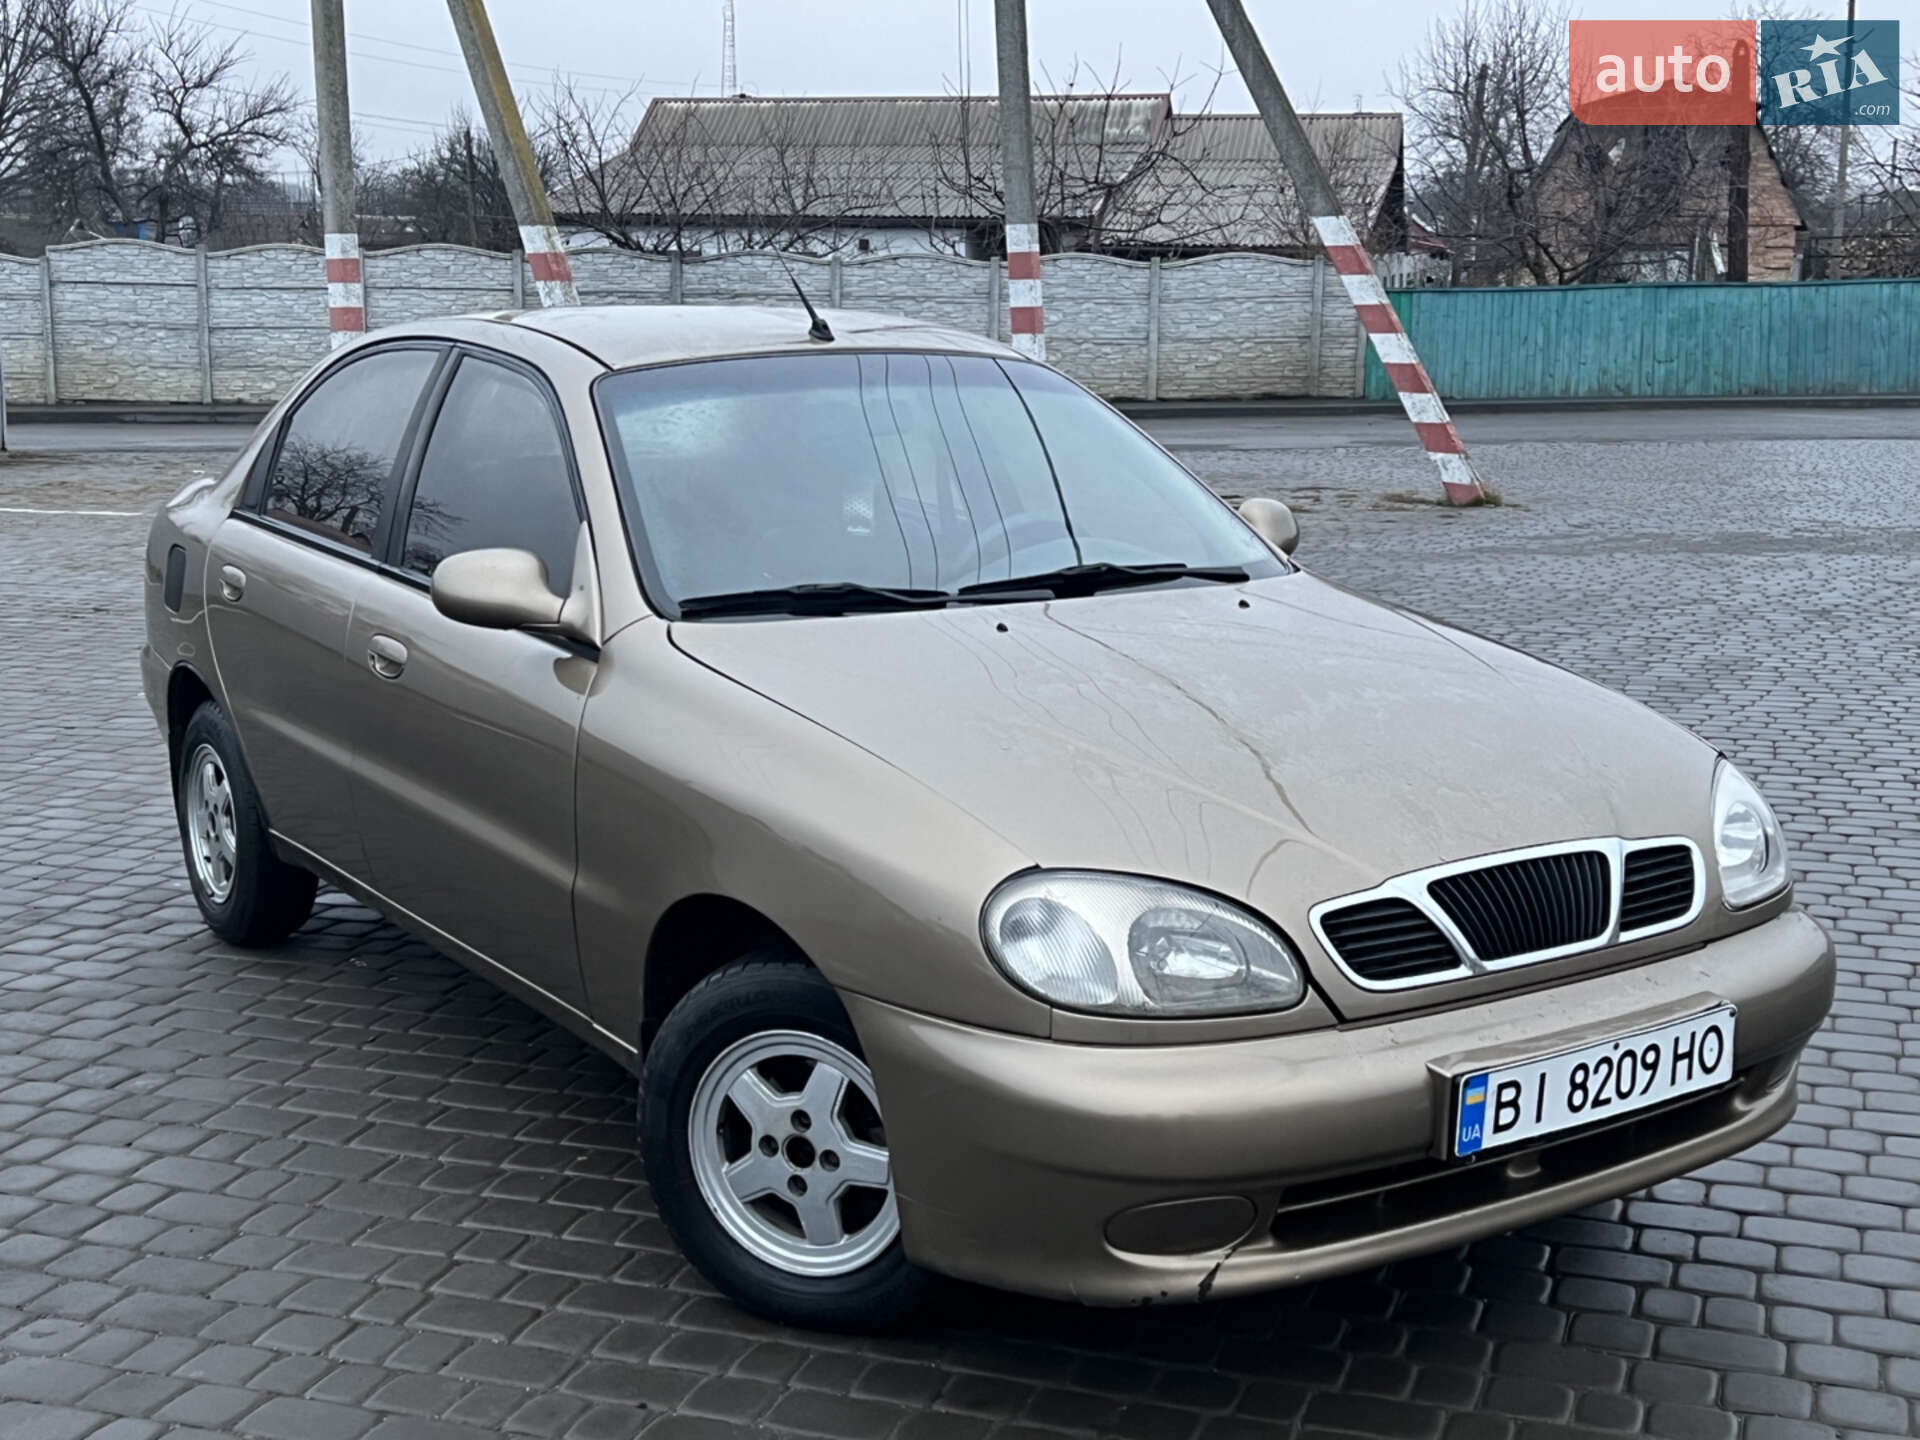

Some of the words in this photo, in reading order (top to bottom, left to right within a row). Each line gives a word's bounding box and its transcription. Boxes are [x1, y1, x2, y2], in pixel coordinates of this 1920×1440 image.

[1492, 1072, 1547, 1135] BI
[1567, 1043, 1661, 1114] 8209
[1670, 1024, 1724, 1087] HO
[1462, 1123, 1481, 1142] UA
